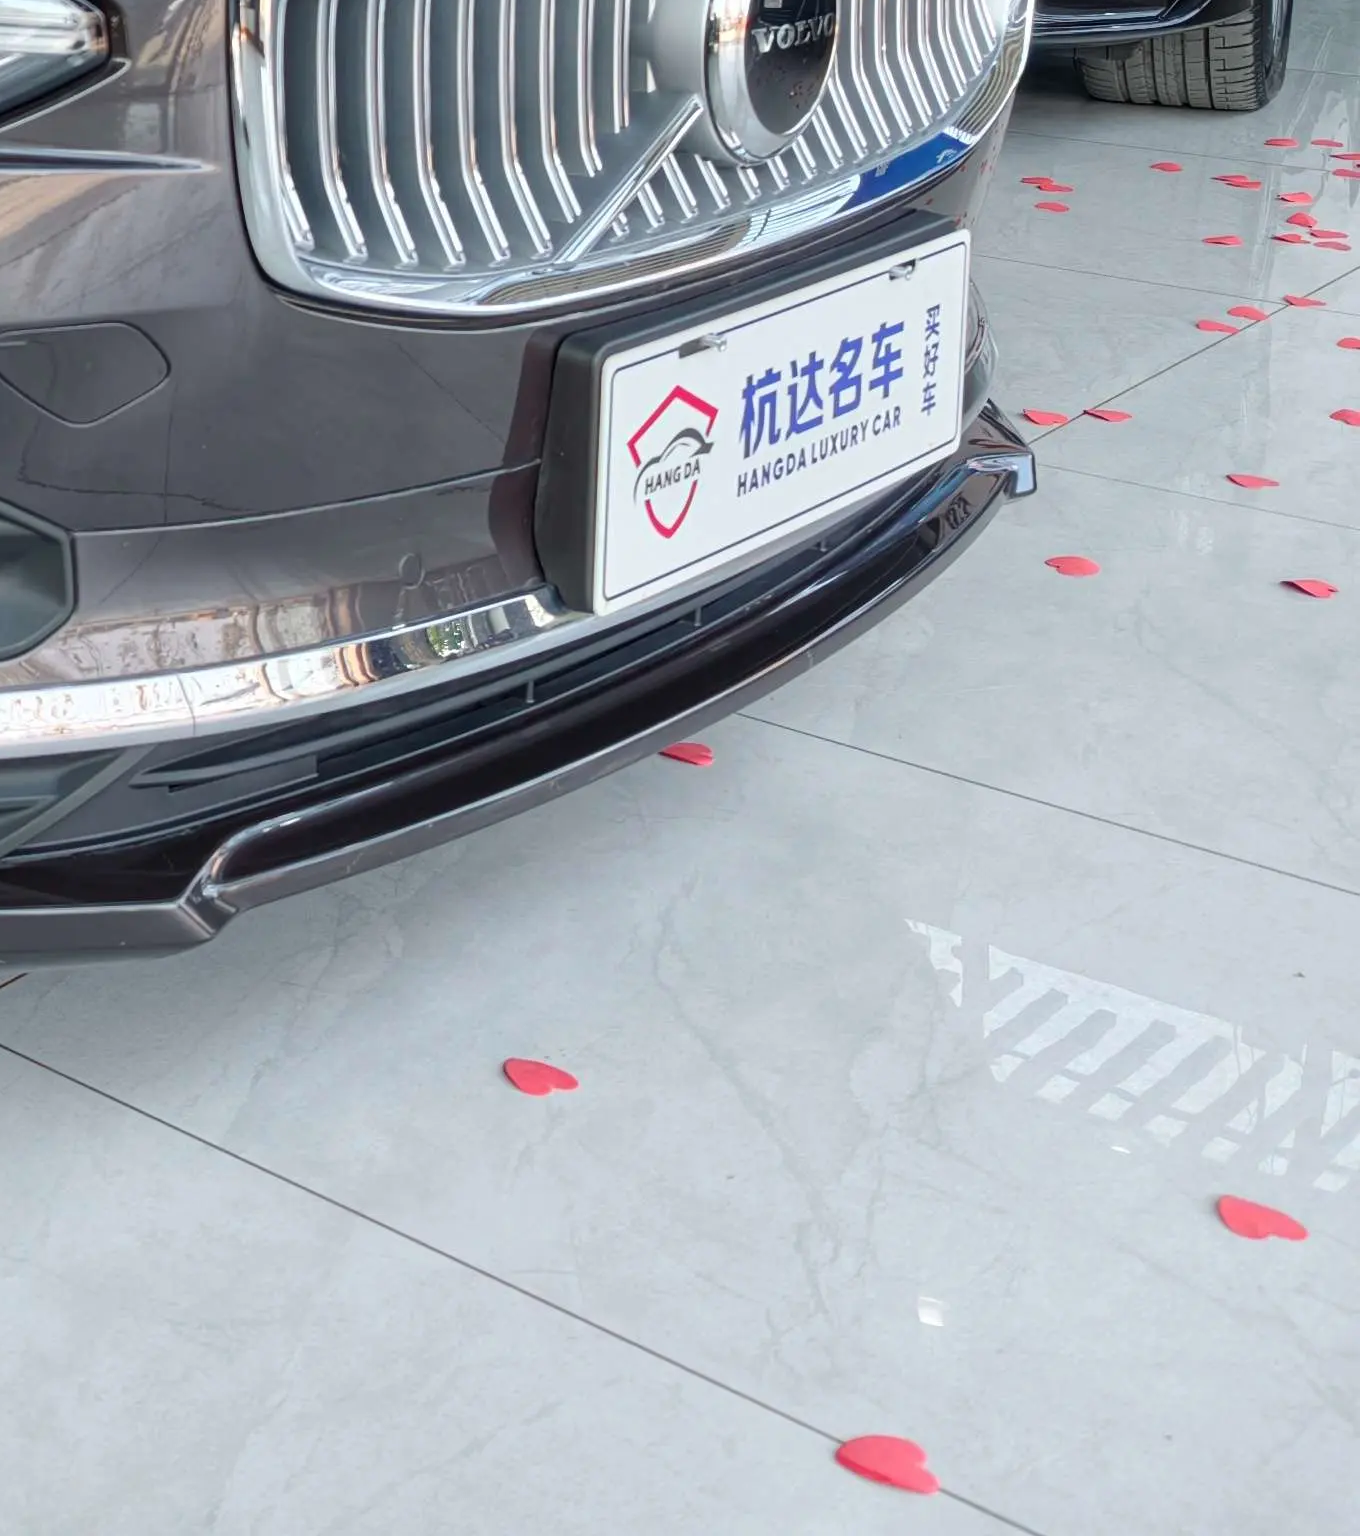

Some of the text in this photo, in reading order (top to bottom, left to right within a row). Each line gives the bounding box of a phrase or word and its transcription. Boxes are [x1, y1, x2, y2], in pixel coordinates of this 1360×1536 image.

[751, 13, 836, 54] VOLVO
[739, 321, 904, 459] 杭达名车
[644, 459, 701, 496] HANG DA
[737, 406, 901, 497] HANGDA LUXURY CAR
